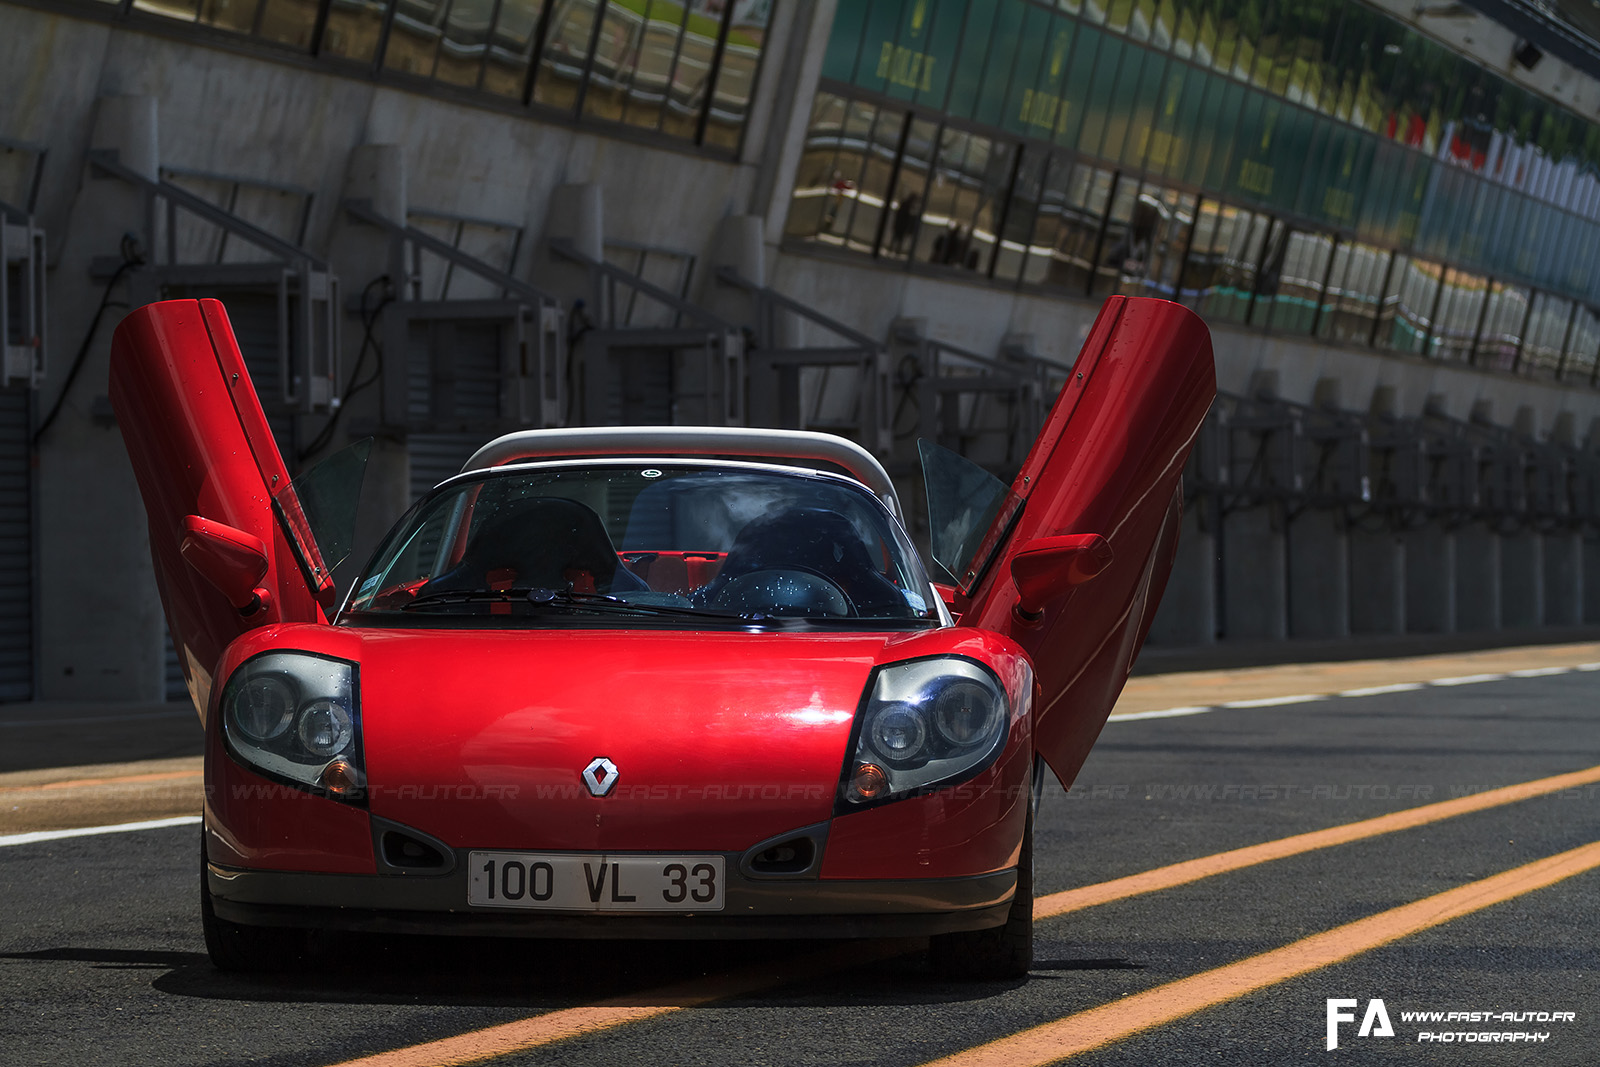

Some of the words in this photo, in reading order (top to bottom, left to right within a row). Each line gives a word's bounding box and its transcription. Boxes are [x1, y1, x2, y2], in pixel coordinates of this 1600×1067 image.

[483, 860, 554, 902] 100
[583, 862, 637, 903] VL
[662, 863, 716, 903] 33
